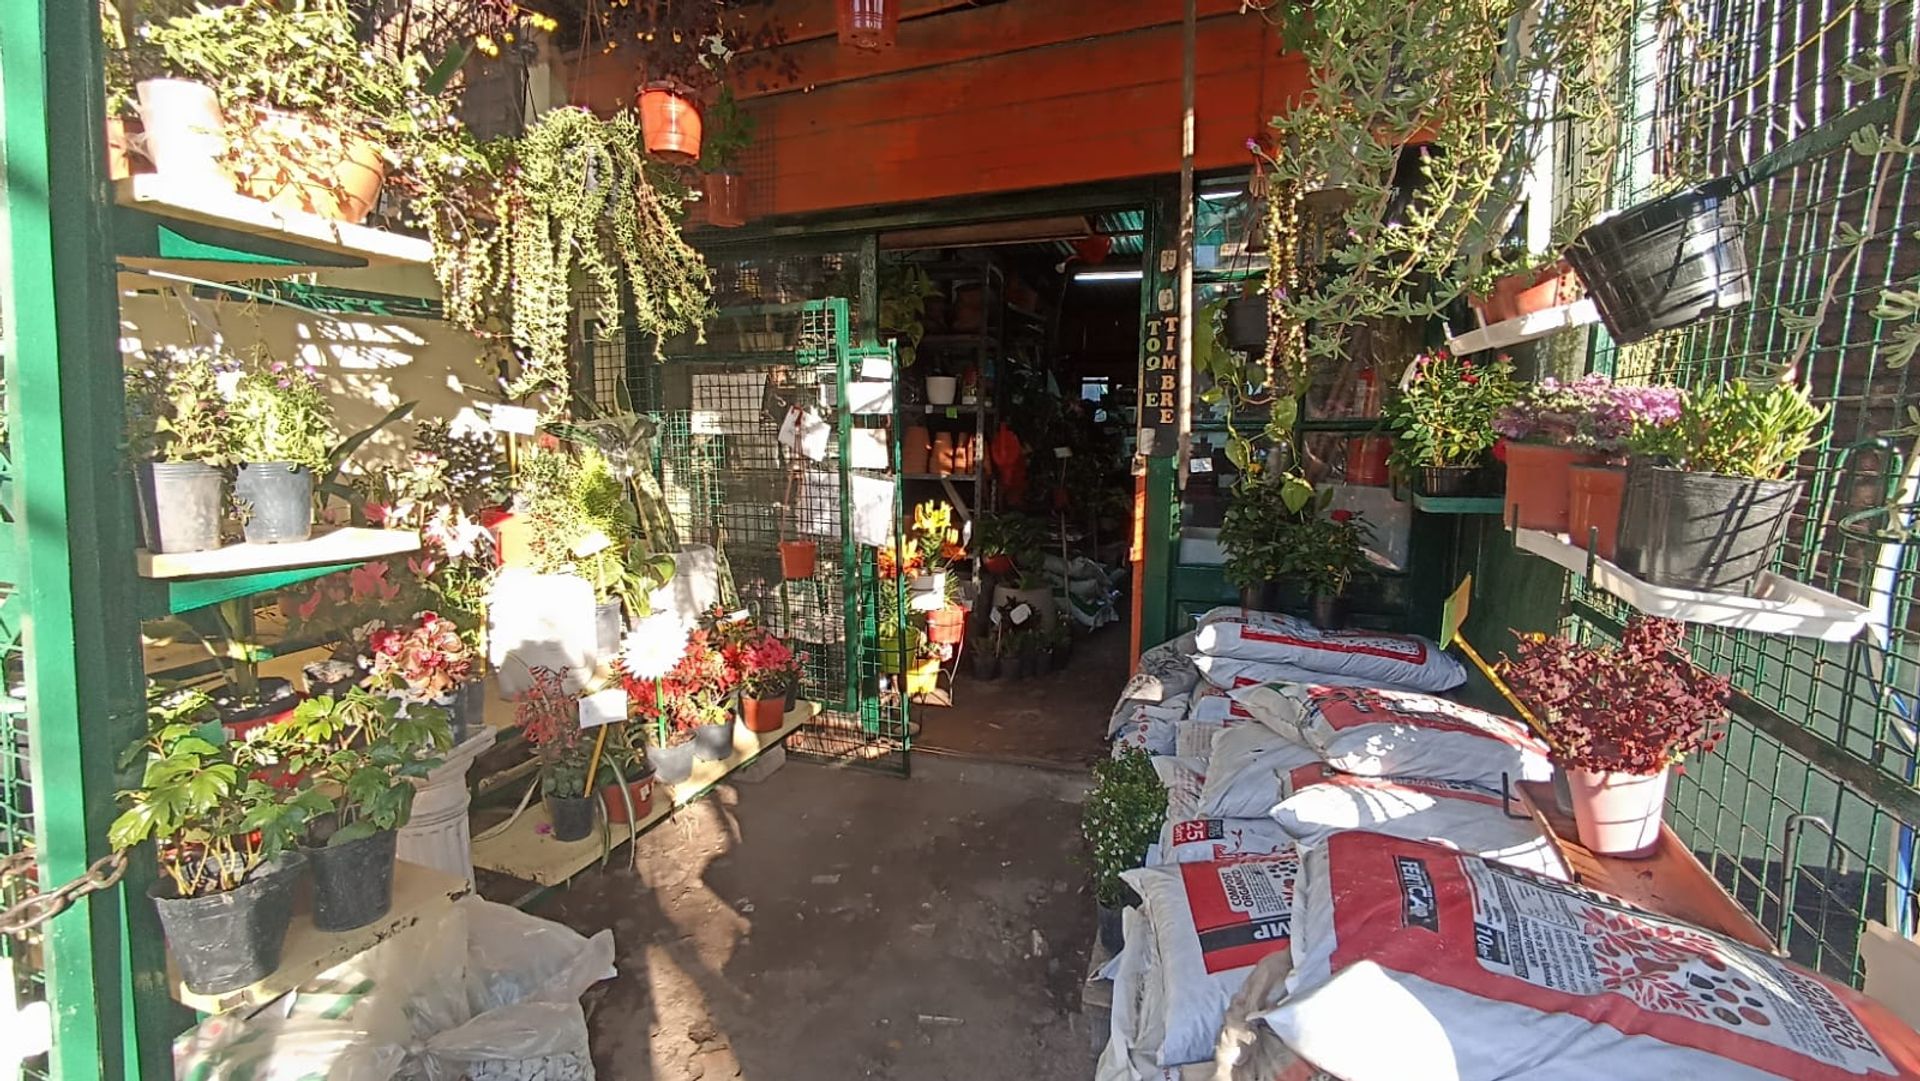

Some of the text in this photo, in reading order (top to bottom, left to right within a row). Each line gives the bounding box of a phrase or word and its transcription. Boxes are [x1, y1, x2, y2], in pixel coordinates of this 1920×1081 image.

[1145, 320, 1161, 408] TOQE
[1160, 316, 1179, 424] TIMBRE
[1186, 821, 1204, 840] 25
[1221, 872, 1242, 907] COMPOST
[1475, 928, 1493, 945] 10
[1804, 979, 1881, 1057] COMPOST
